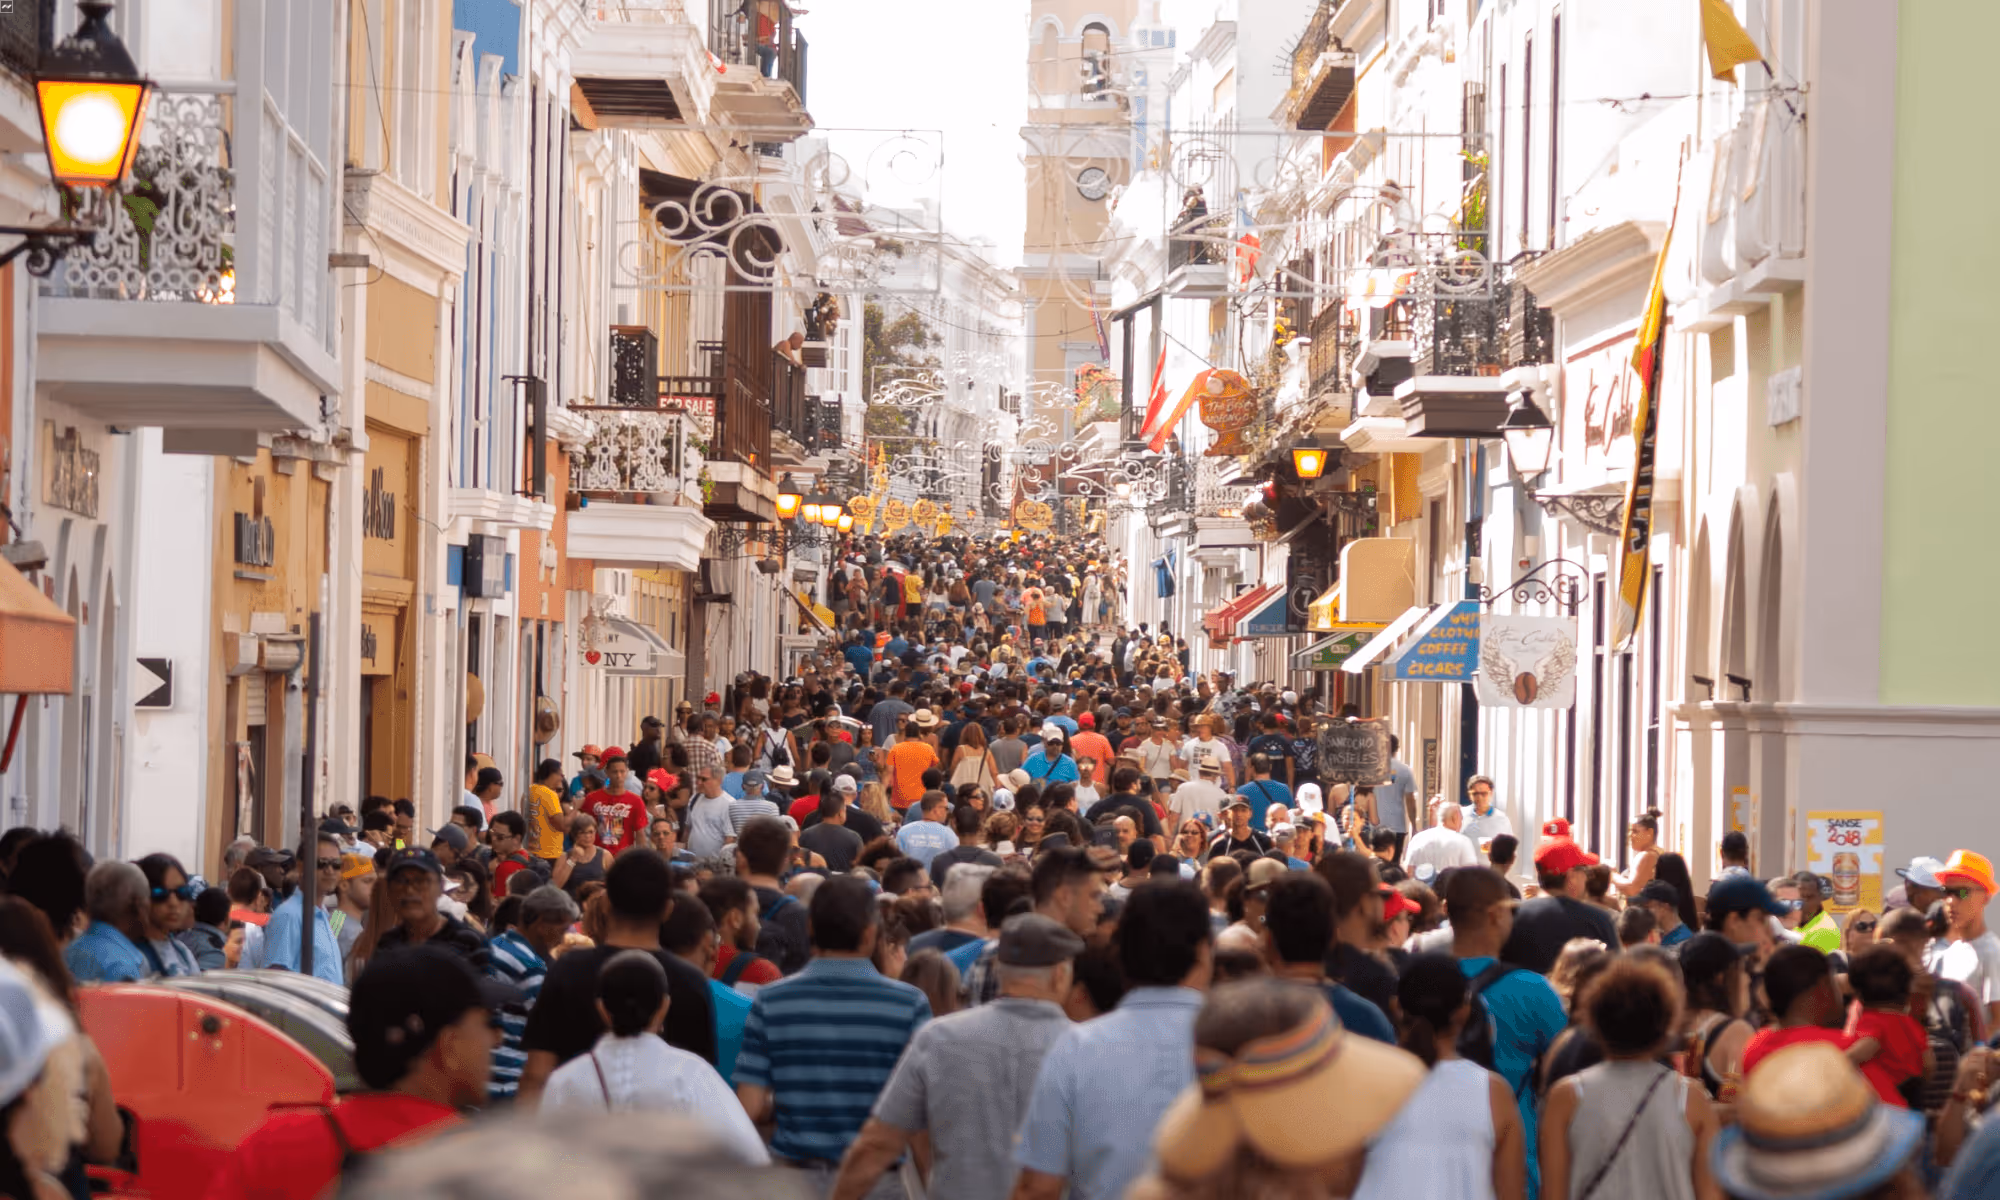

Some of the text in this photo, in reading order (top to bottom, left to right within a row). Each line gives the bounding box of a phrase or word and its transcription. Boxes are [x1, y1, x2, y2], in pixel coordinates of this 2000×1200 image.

[685, 399, 713, 416] SALE
[1301, 589, 1312, 609] 7
[1418, 643, 1468, 655] COFFEE
[603, 652, 636, 667] NY
[1407, 662, 1464, 676] CIGARS
[1828, 818, 1863, 828] SANSE
[1827, 826, 1862, 846] 2018
